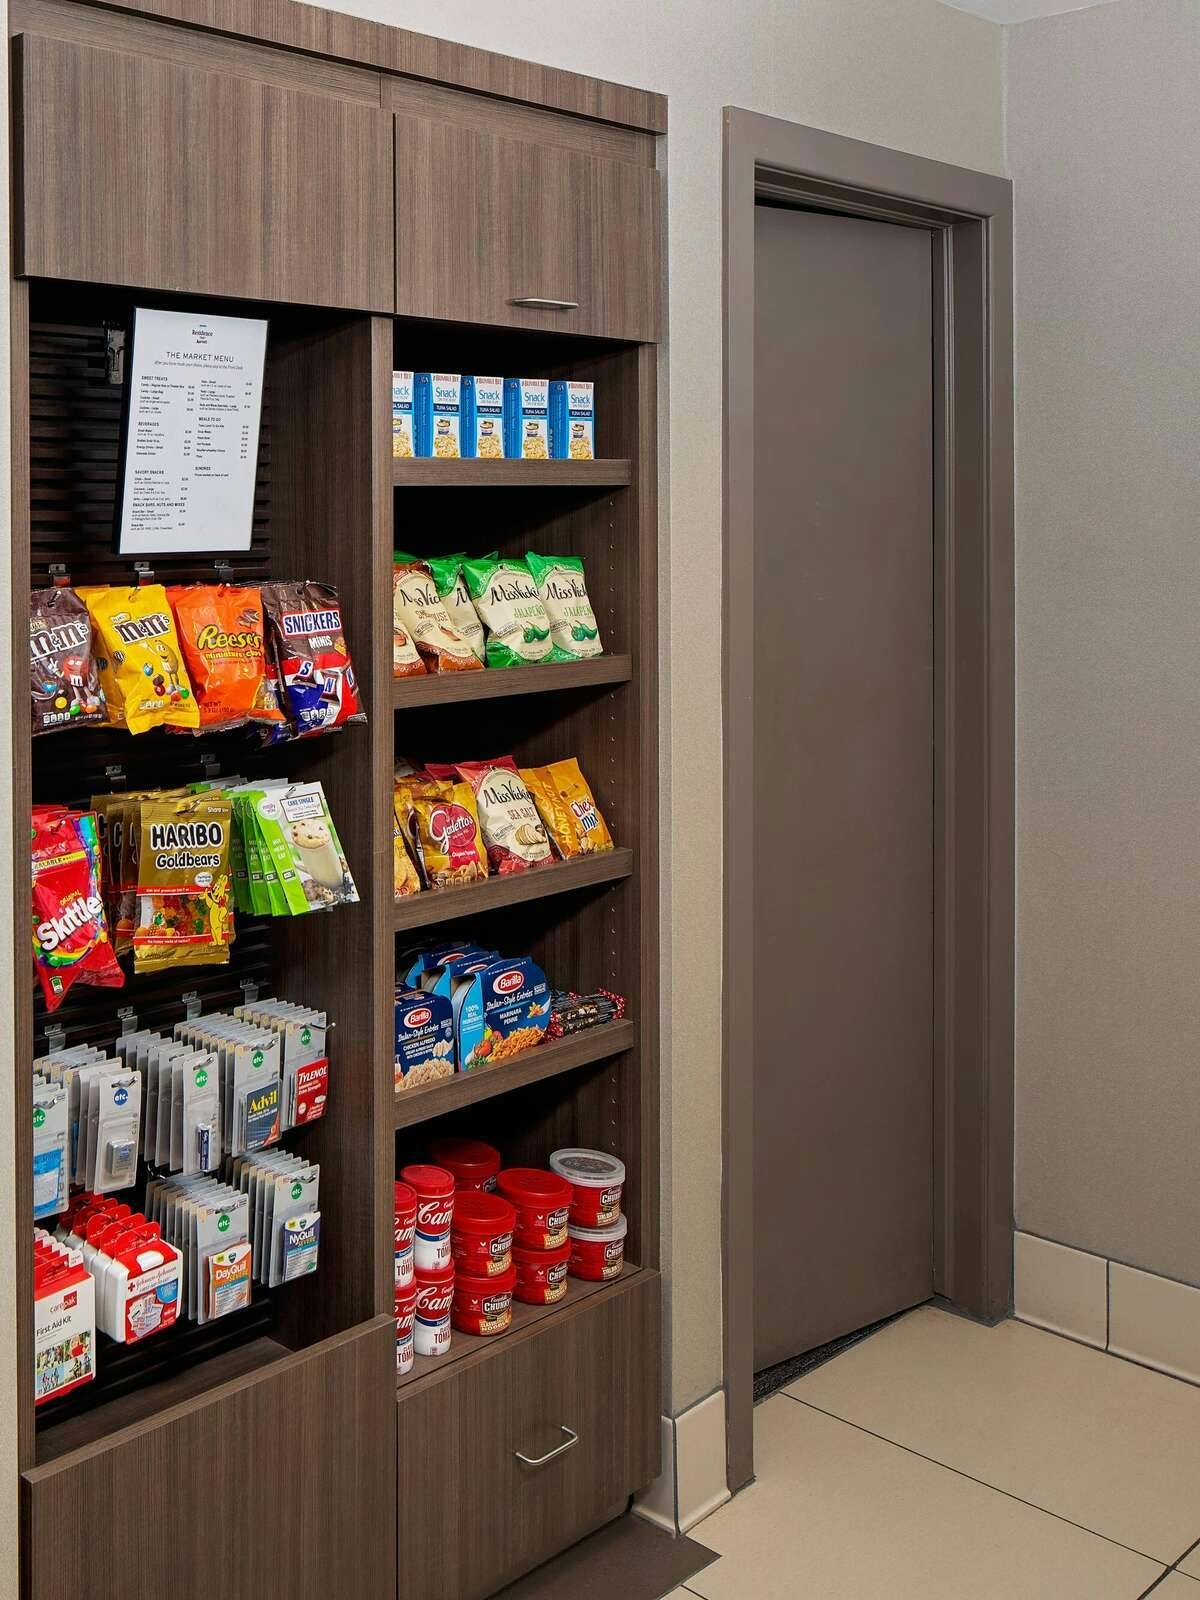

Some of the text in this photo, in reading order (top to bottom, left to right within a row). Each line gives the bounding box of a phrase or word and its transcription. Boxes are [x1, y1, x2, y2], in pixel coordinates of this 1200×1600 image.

[166, 351, 234, 363] THE MARKET MENU
[435, 386, 457, 398] Snack
[479, 390, 500, 400] Snack
[524, 392, 545, 402] Snack
[571, 394, 591, 404] Snack
[284, 612, 340, 635] SNICKERS
[507, 807, 536, 820] SEA SALT
[554, 804, 572, 845] HONEY
[151, 822, 223, 850] HARIBO
[156, 852, 221, 870] Goldbears
[500, 974, 522, 989] Barilla
[500, 1008, 522, 1020] MARINARA
[299, 1066, 328, 1085] TYLENOL
[249, 1090, 277, 1112] Advil
[289, 1228, 314, 1245] NyQuil
[215, 1261, 247, 1281] DayQuil
[36, 1315, 72, 1337] First Aid Kit
